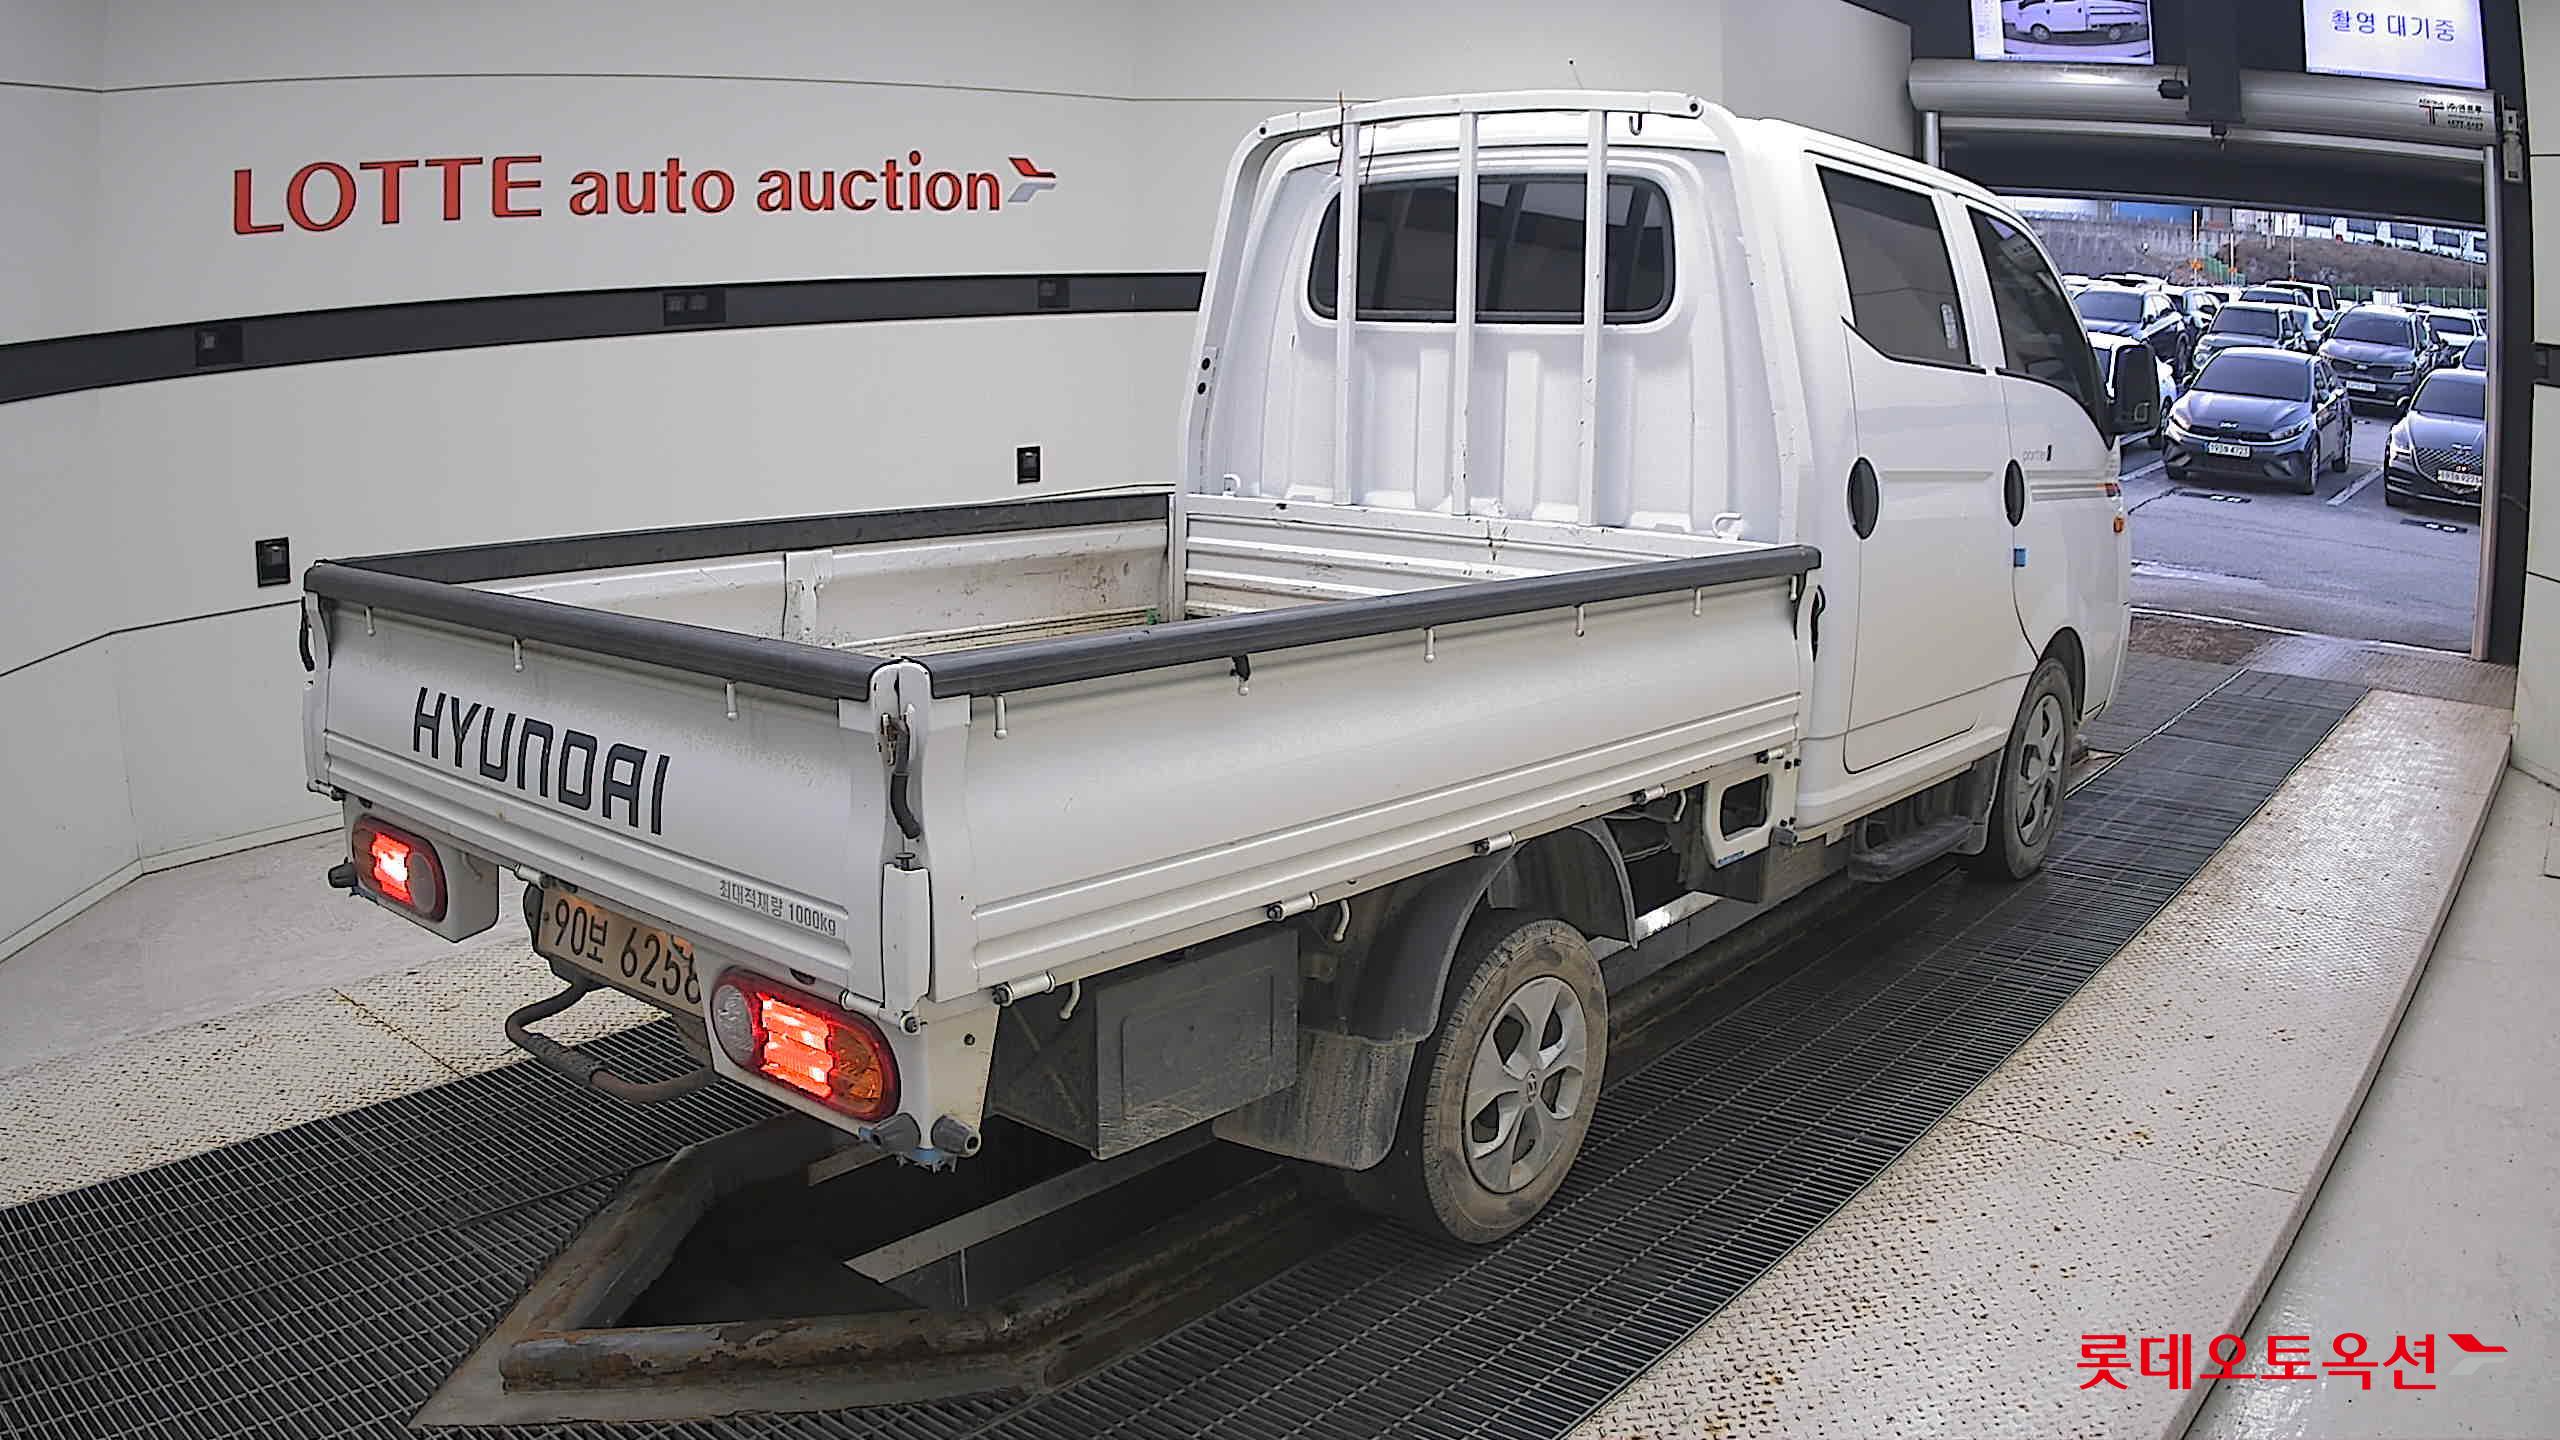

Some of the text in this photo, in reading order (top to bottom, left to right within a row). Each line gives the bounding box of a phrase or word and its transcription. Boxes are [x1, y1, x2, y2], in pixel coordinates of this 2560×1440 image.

[2331, 9, 2455, 42] 촬영 대기중
[233, 150, 1001, 235] LOTTE auto auction
[413, 686, 671, 836] HYUNDAI
[555, 898, 609, 964] 90보
[719, 879, 837, 937] 최대적재량 1000kg
